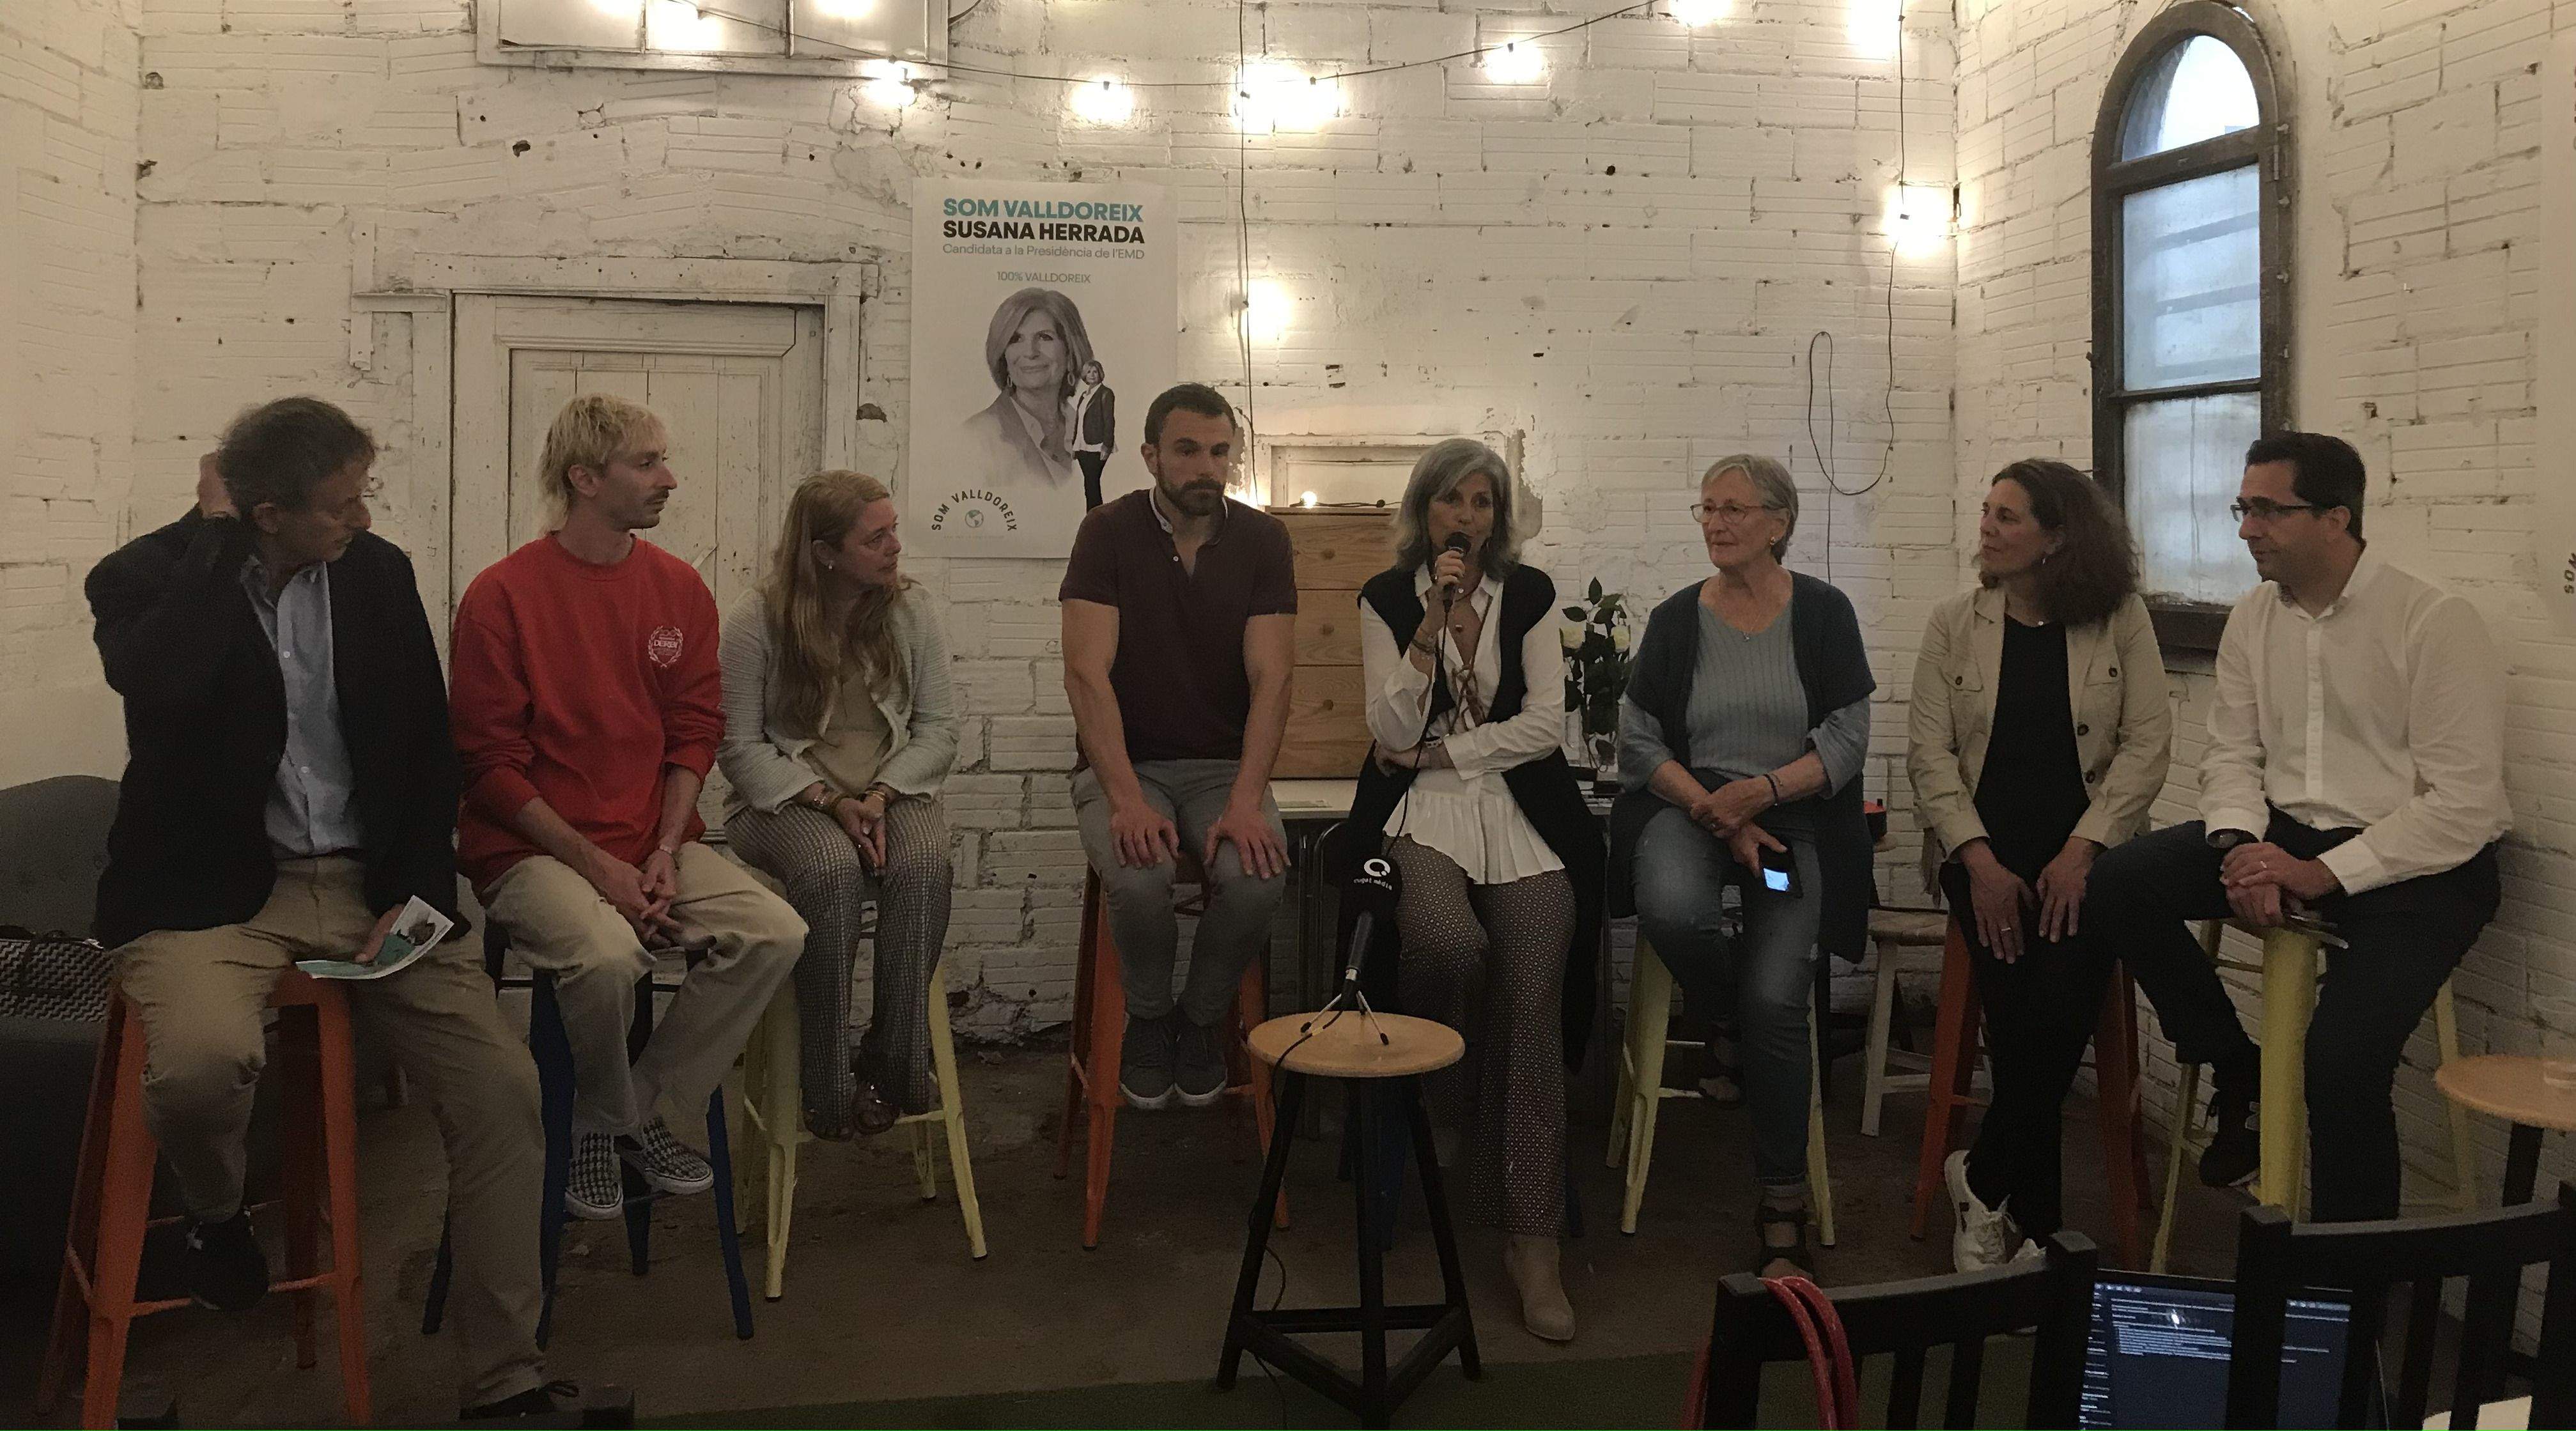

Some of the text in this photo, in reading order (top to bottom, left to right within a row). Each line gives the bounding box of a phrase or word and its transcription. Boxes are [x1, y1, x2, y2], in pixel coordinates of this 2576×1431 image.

[943, 198, 1144, 222] SOM VALLDOREIX
[943, 220, 1145, 244] SUSANA HERRADA
[942, 244, 1003, 255] Candidata
[1014, 246, 1024, 256] la
[1094, 249, 1110, 259] de
[997, 271, 1091, 284] 100% VALLDOREIX
[931, 489, 1017, 531] SOM VALLDOREIX
